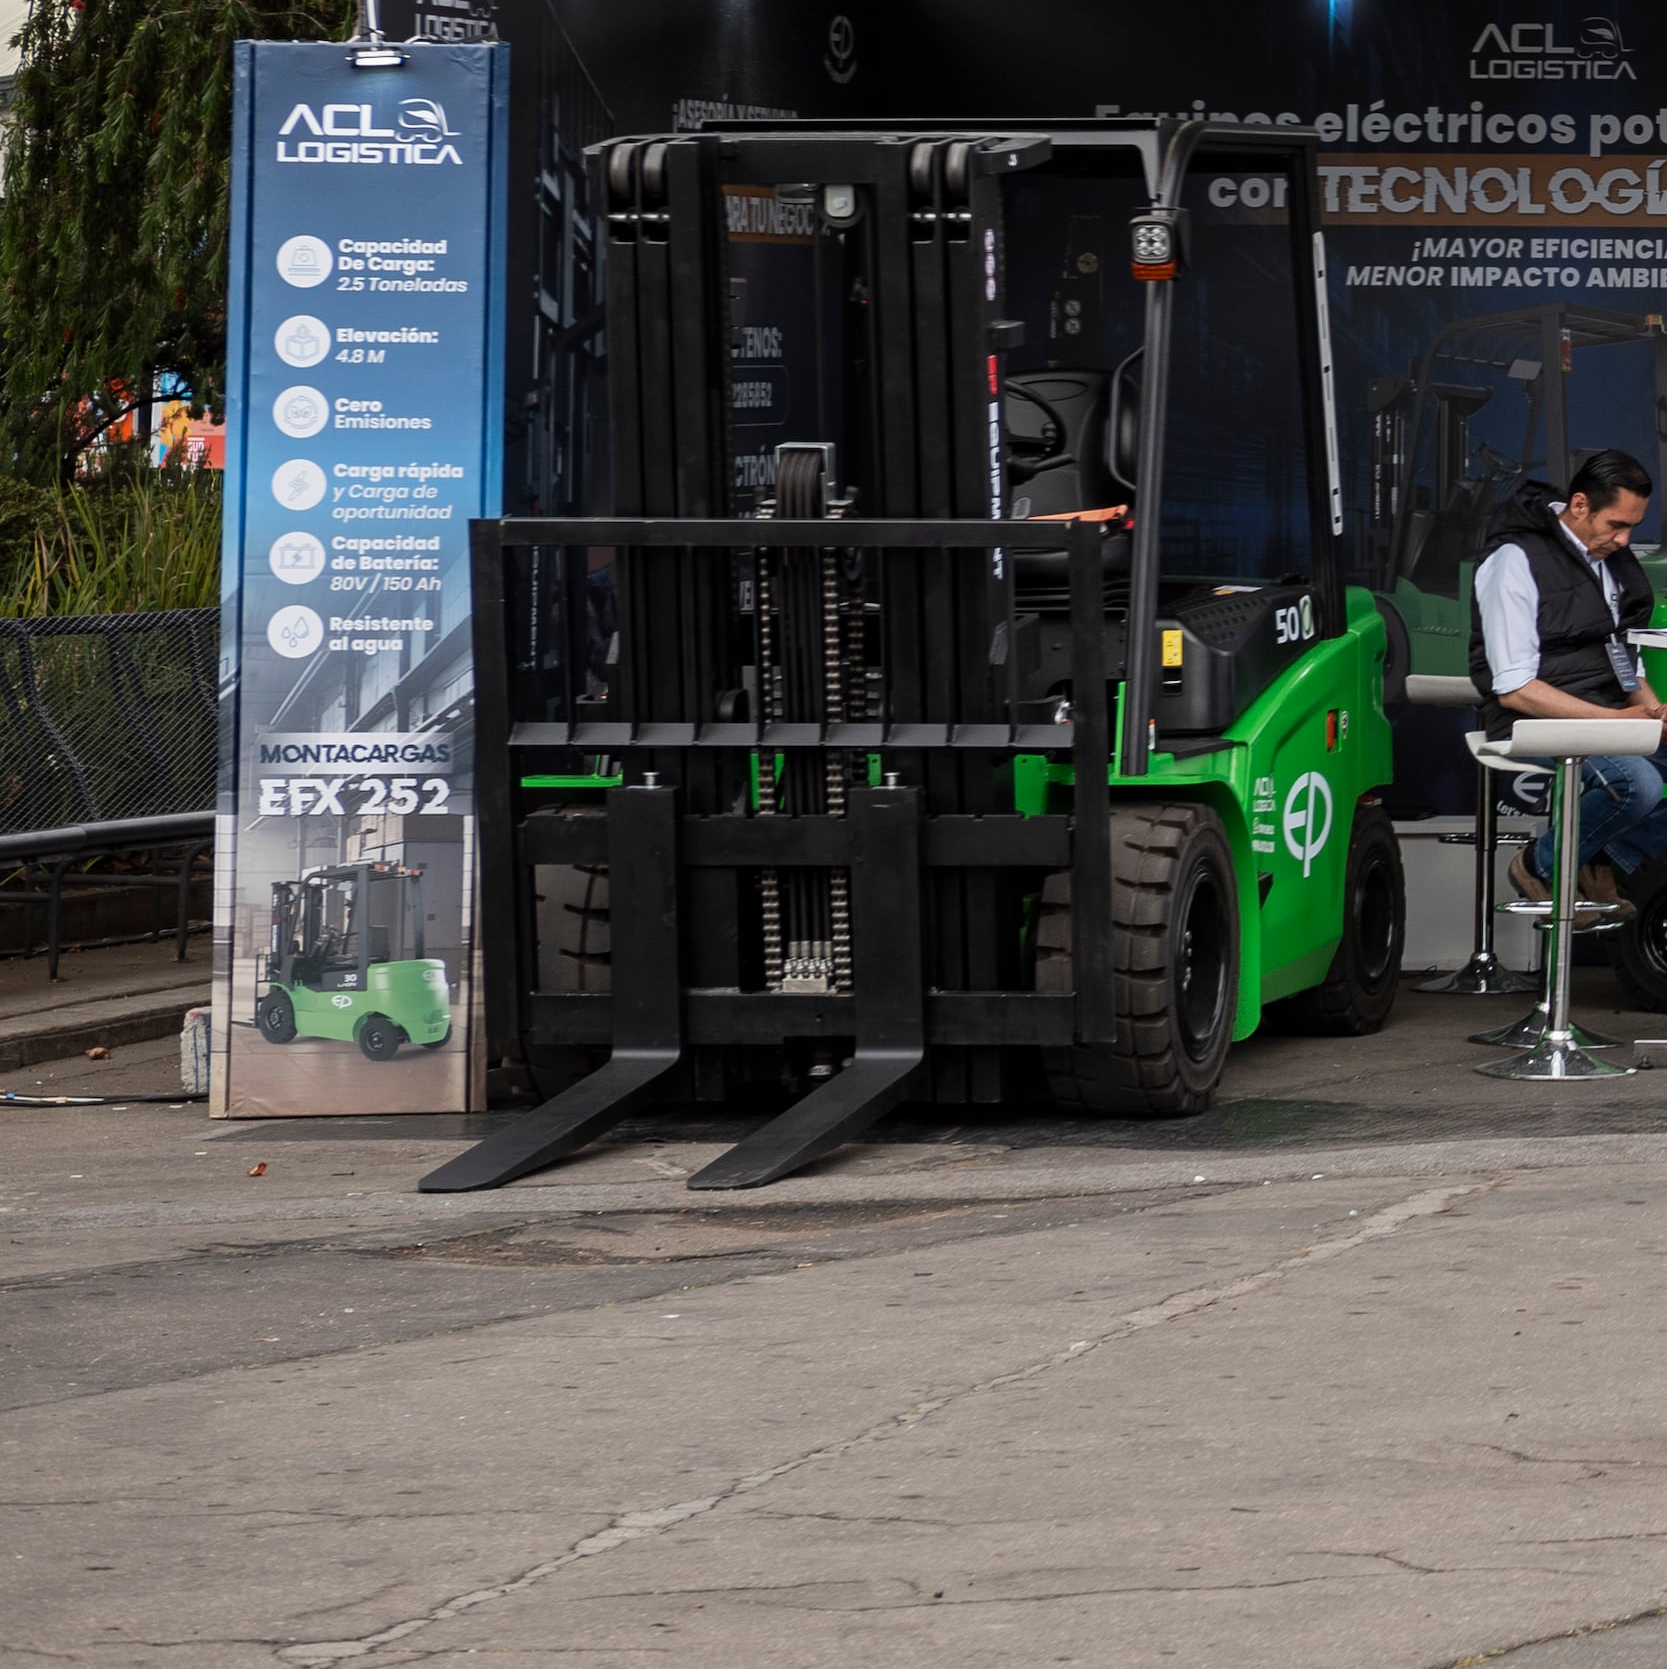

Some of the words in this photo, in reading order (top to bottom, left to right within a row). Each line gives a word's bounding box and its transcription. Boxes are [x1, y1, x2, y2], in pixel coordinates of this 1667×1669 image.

[1470, 23, 1575, 57] ACL
[1470, 61, 1637, 80] LOGISTICA
[278, 103, 395, 136] ACL
[1314, 99, 1576, 143] eléctricos
[276, 142, 463, 164] LOGISTICA
[339, 238, 447, 258] Capacidad
[1411, 238, 1522, 263] ¡MAYOR
[338, 257, 363, 272] De
[367, 256, 434, 277] Carga:
[337, 278, 364, 293] 2.5
[368, 277, 468, 293] Toneladas
[1346, 267, 1442, 288] MENOR
[1451, 267, 1580, 288] IMPACTO
[336, 327, 439, 345] Elevación:
[335, 349, 363, 364] 4.8
[367, 349, 386, 364] M
[335, 398, 382, 413] Cero
[335, 414, 432, 430] Emisiones
[334, 464, 393, 483] Carga
[398, 463, 464, 483] rápida
[333, 488, 343, 502] y
[347, 483, 409, 502] Carga
[414, 483, 438, 499] de
[332, 503, 452, 522] oportunidad
[332, 536, 440, 553] Capacidad
[332, 555, 355, 570] de
[360, 554, 439, 571] Batería:
[330, 576, 366, 591] 80V
[383, 576, 418, 591] 150
[422, 575, 442, 591] Ah
[329, 616, 434, 632] Resistente
[328, 636, 344, 651] al
[348, 637, 404, 656] agua
[259, 743, 450, 764] MONTACARGAS
[258, 779, 348, 816] EFX
[358, 778, 449, 816] 252
